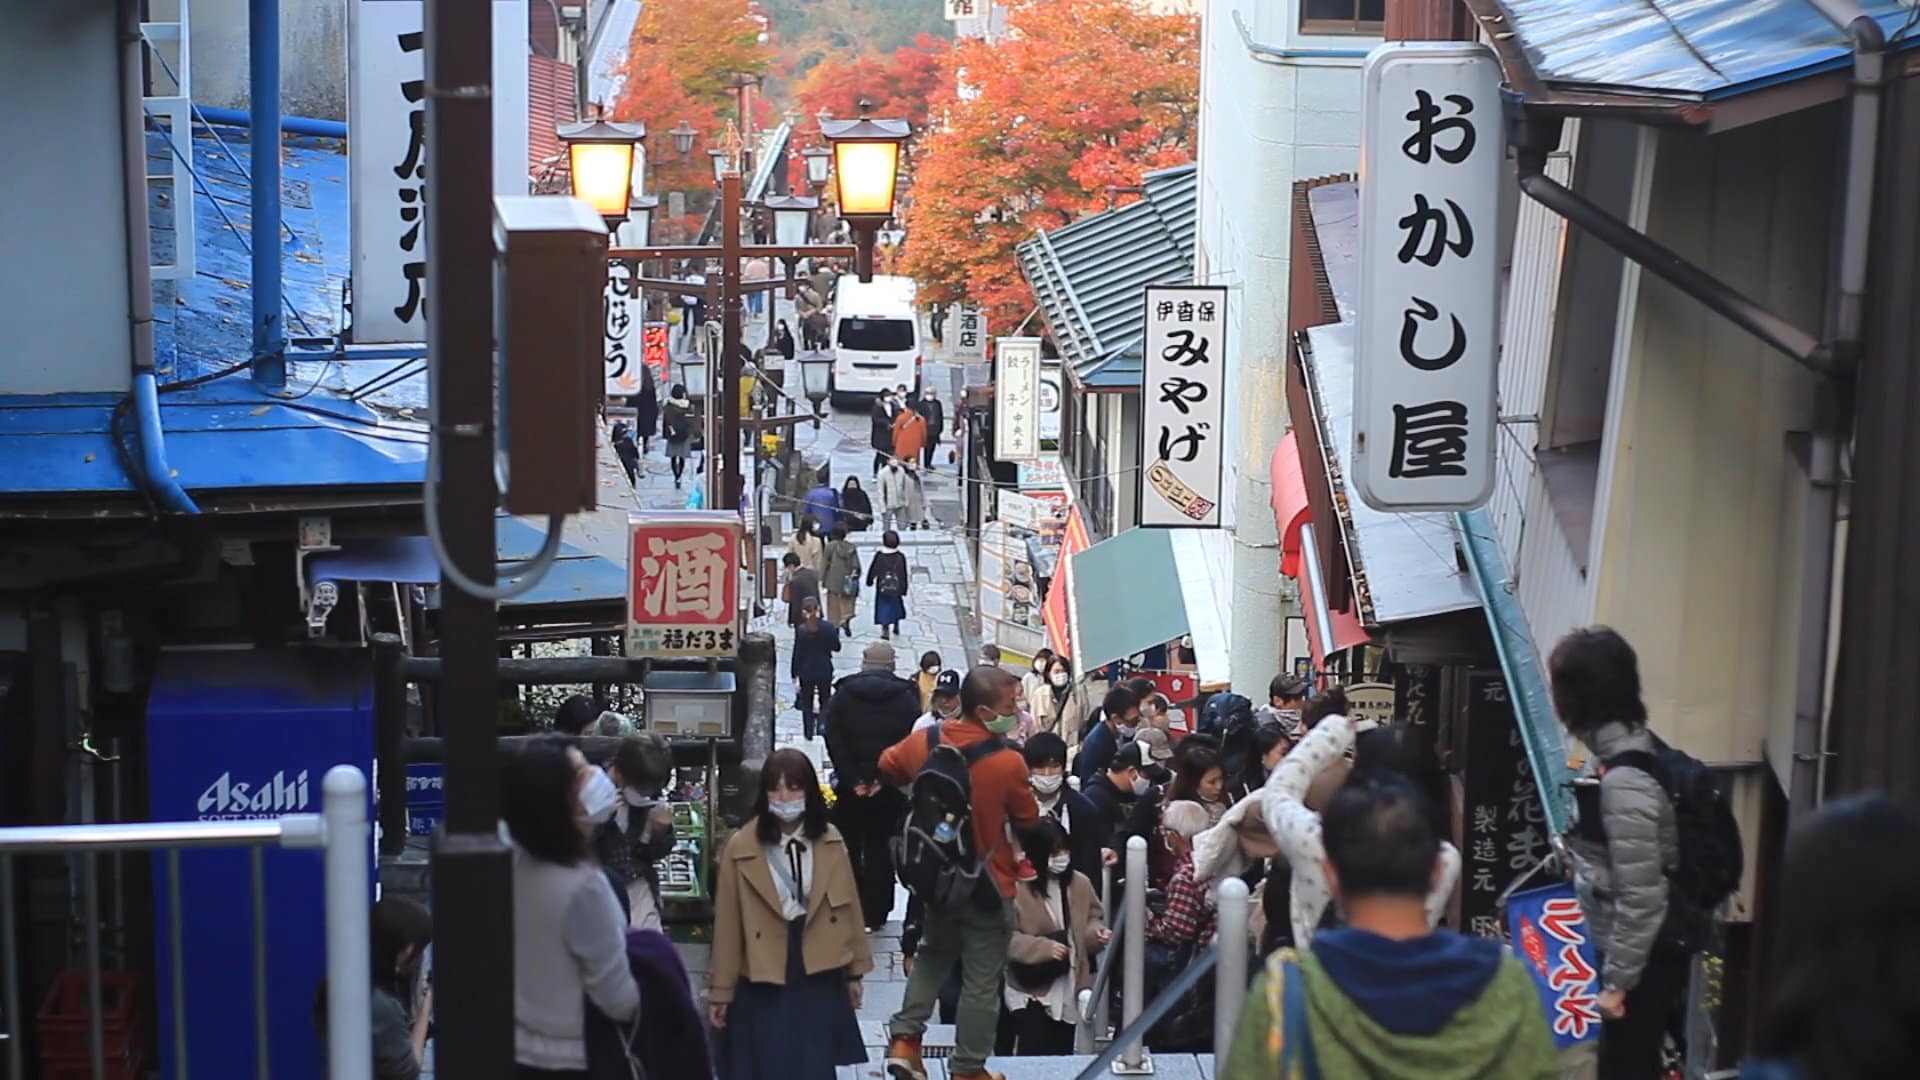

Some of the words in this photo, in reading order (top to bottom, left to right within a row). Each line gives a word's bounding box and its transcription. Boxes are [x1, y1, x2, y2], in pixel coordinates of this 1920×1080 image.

[1157, 300, 1216, 322] 伊香保
[1388, 89, 1477, 480] おかし屋
[1158, 330, 1211, 462] みやげ
[641, 533, 727, 619] 酒
[662, 628, 735, 651] 福だるま
[198, 769, 309, 813] Asahi
[1472, 804, 1499, 892] 製造元
